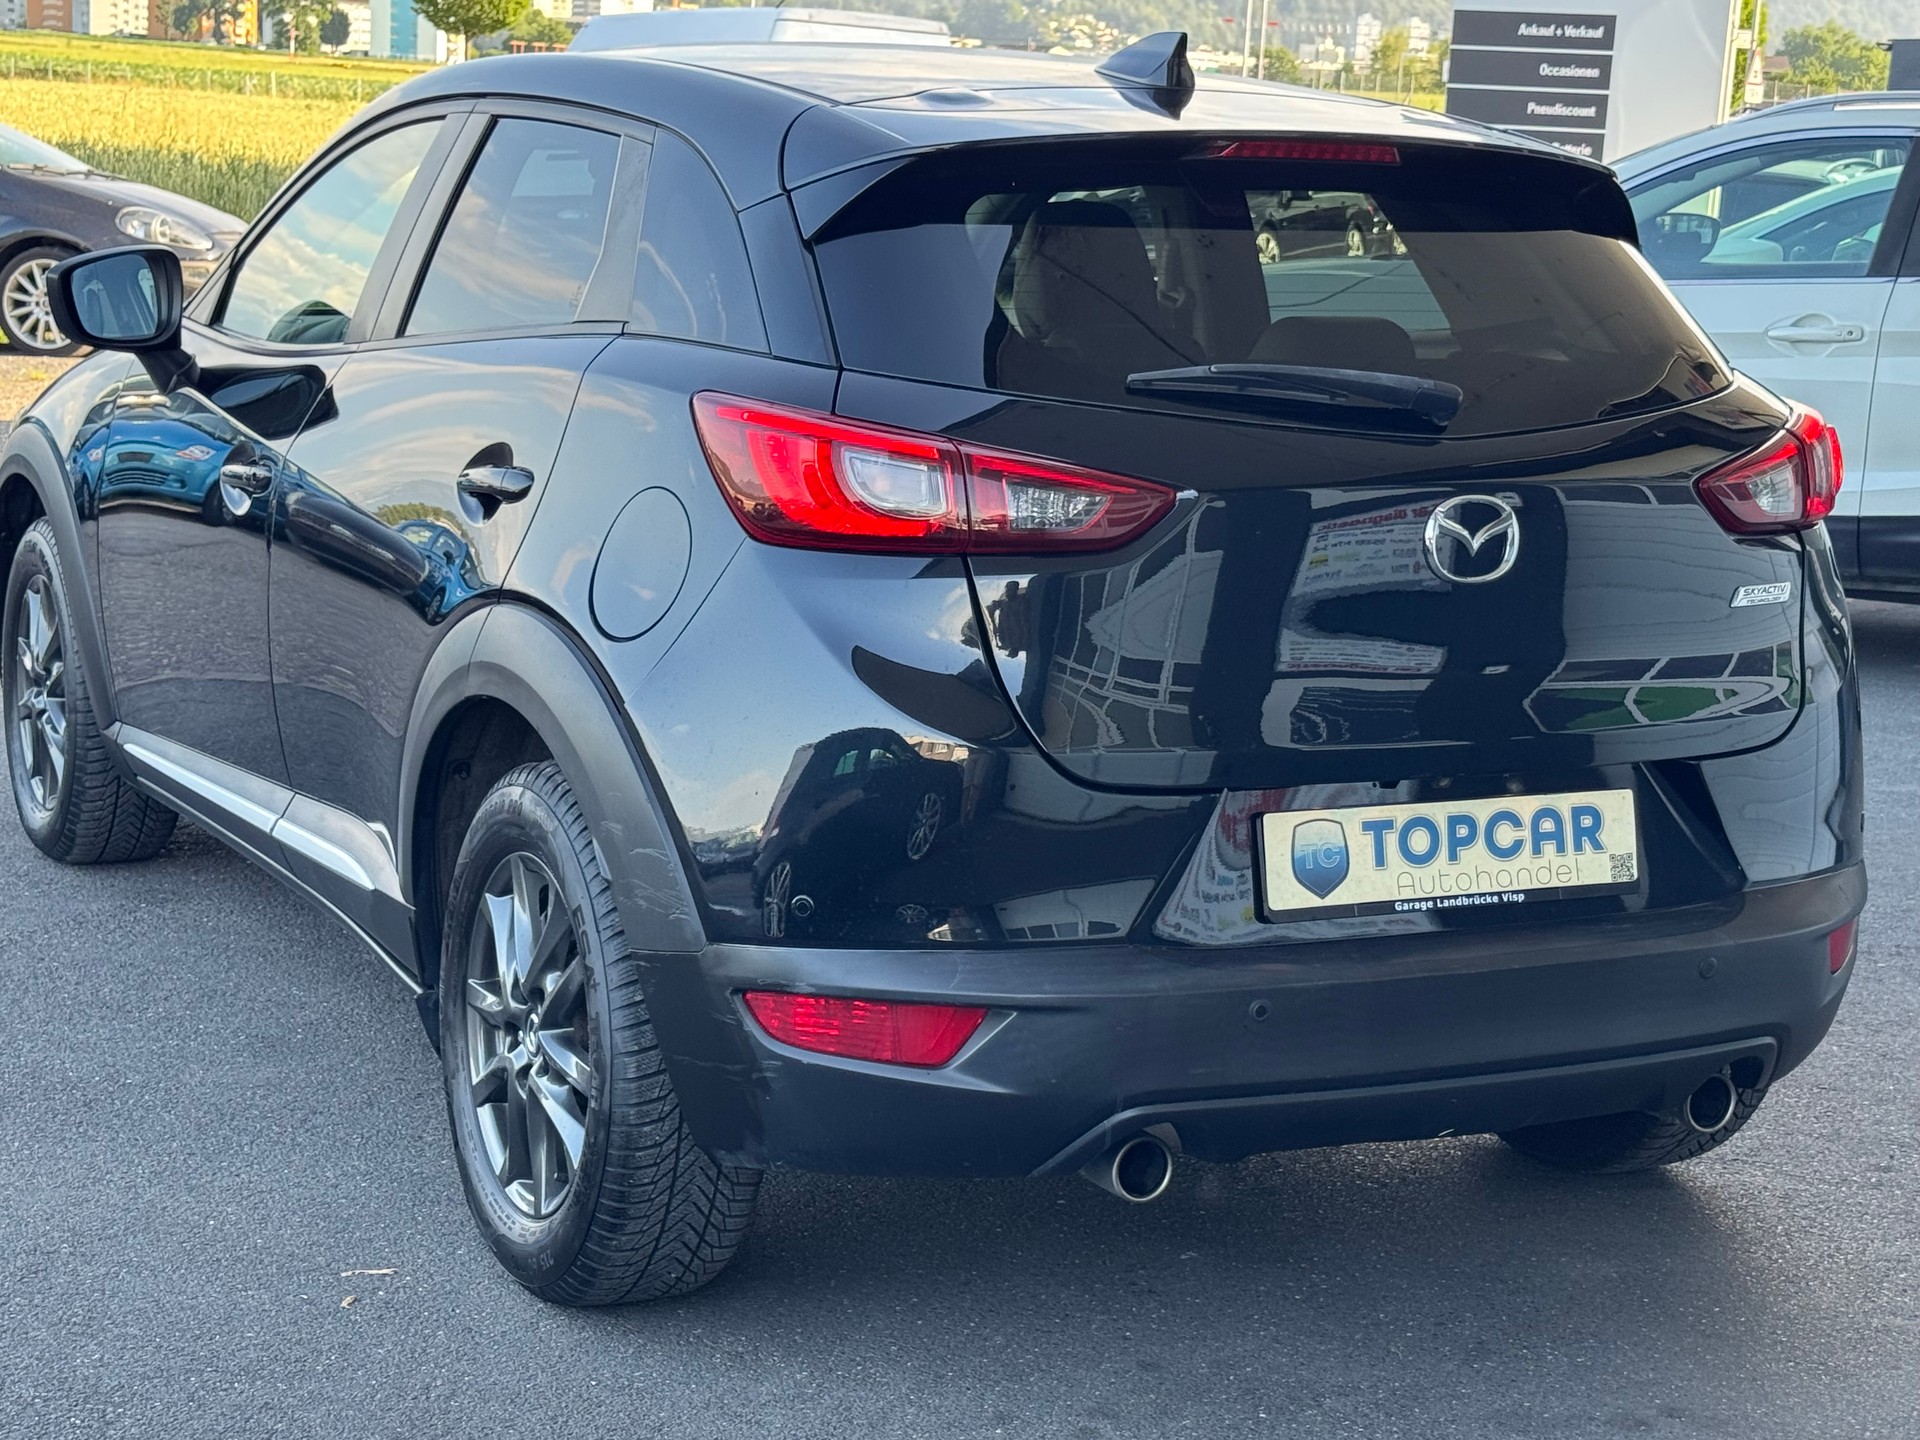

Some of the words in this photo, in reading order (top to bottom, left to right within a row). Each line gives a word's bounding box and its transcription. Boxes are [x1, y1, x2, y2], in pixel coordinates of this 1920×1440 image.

[1517, 23, 1555, 37] Ankauf
[1564, 25, 1604, 39] Verkauf
[1539, 63, 1600, 78] Occasionen
[1527, 102, 1596, 118] Pneudiscount
[1743, 584, 1787, 596] SKYACTIV
[1360, 803, 1607, 871] TOPCAR
[1301, 842, 1341, 870] TC
[1397, 858, 1581, 896] Autohandel
[1394, 899, 1434, 912] Garage
[1436, 894, 1500, 909] Landbrücke
[1501, 892, 1525, 905] Visp
